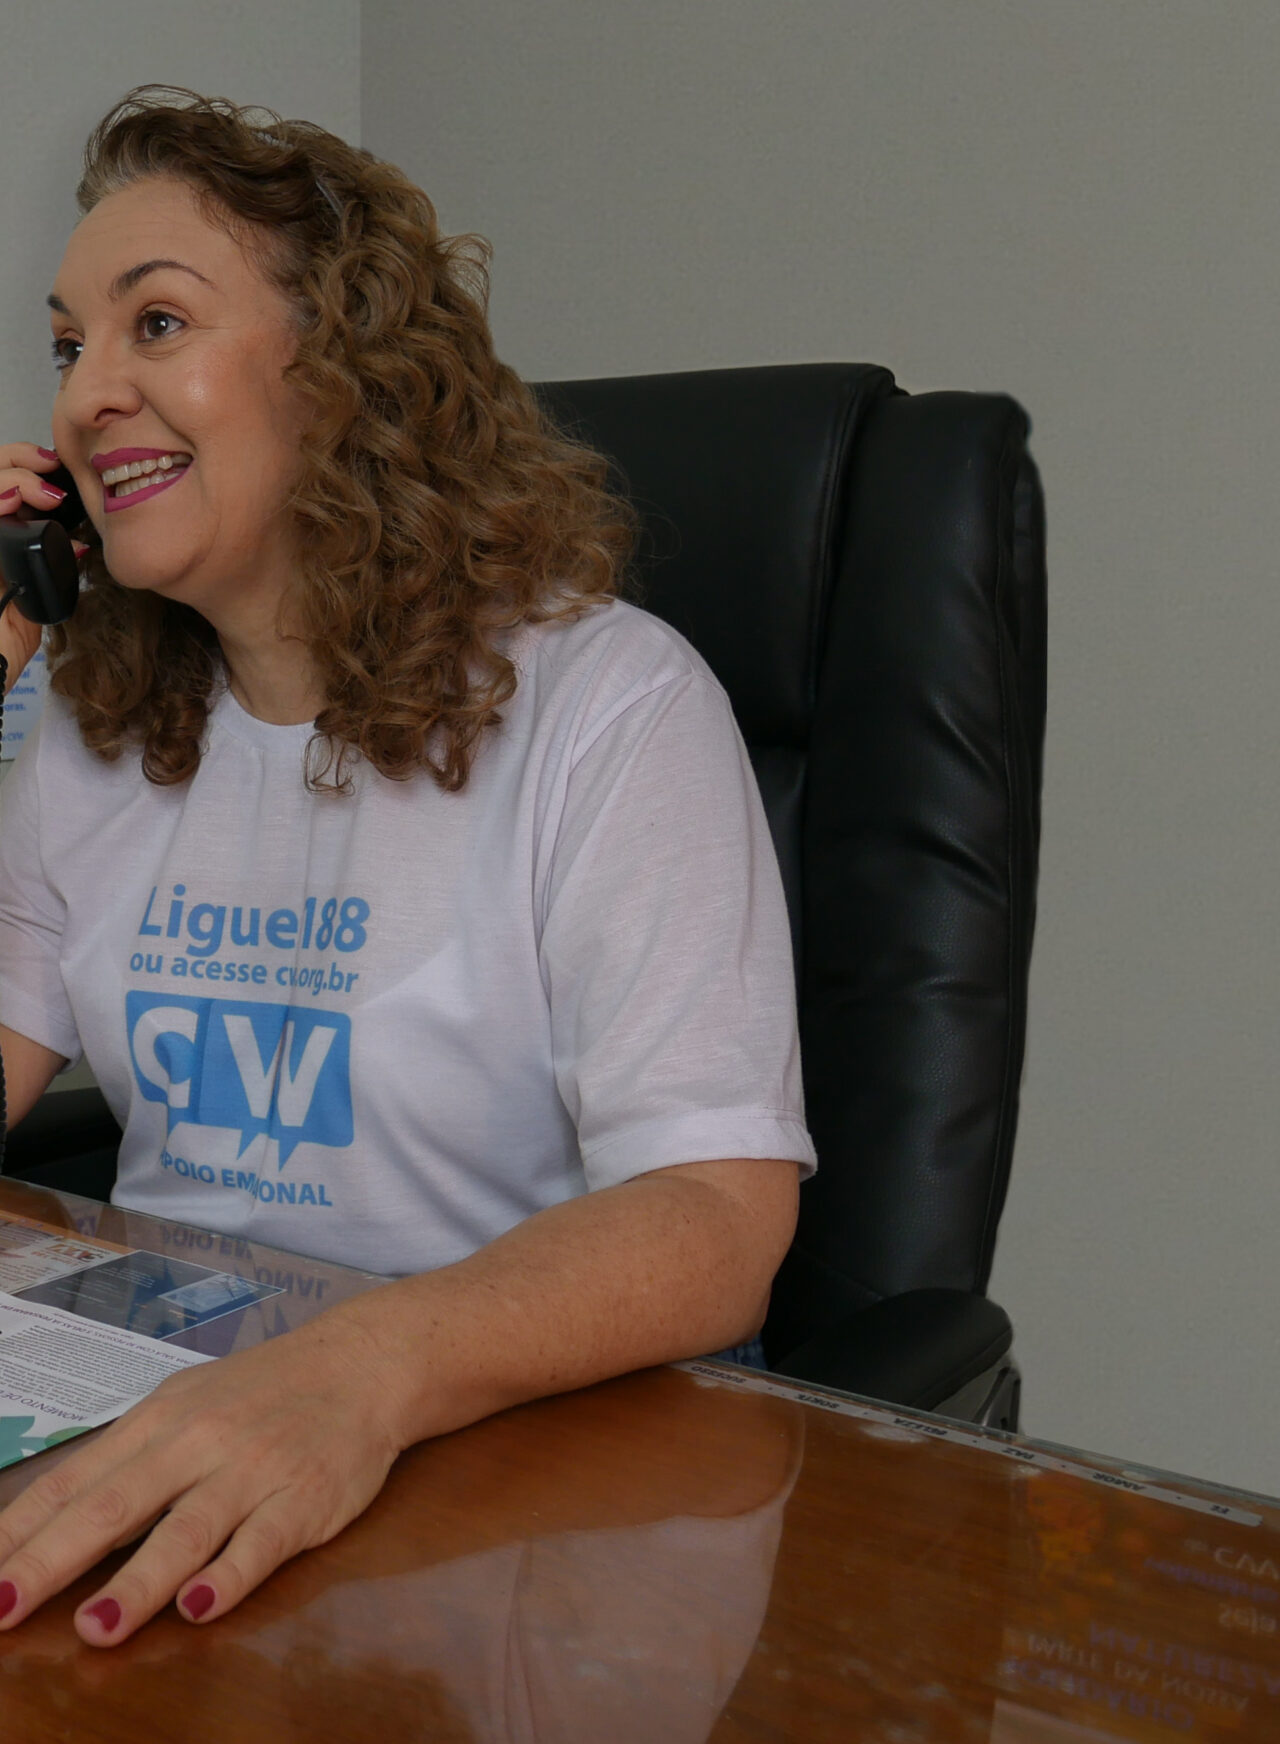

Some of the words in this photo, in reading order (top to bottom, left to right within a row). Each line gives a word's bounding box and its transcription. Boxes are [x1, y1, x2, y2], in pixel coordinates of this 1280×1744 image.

[138, 884, 299, 957] Ligue
[301, 897, 371, 952] 188
[129, 952, 163, 975] ou
[171, 957, 268, 984] acesse
[1, 1392, 21, 1402] DE
[20, 1398, 88, 1422] MOMENTO
[1003, 1446, 1035, 1460] PAZ
[1093, 1471, 1146, 1491] AMOR
